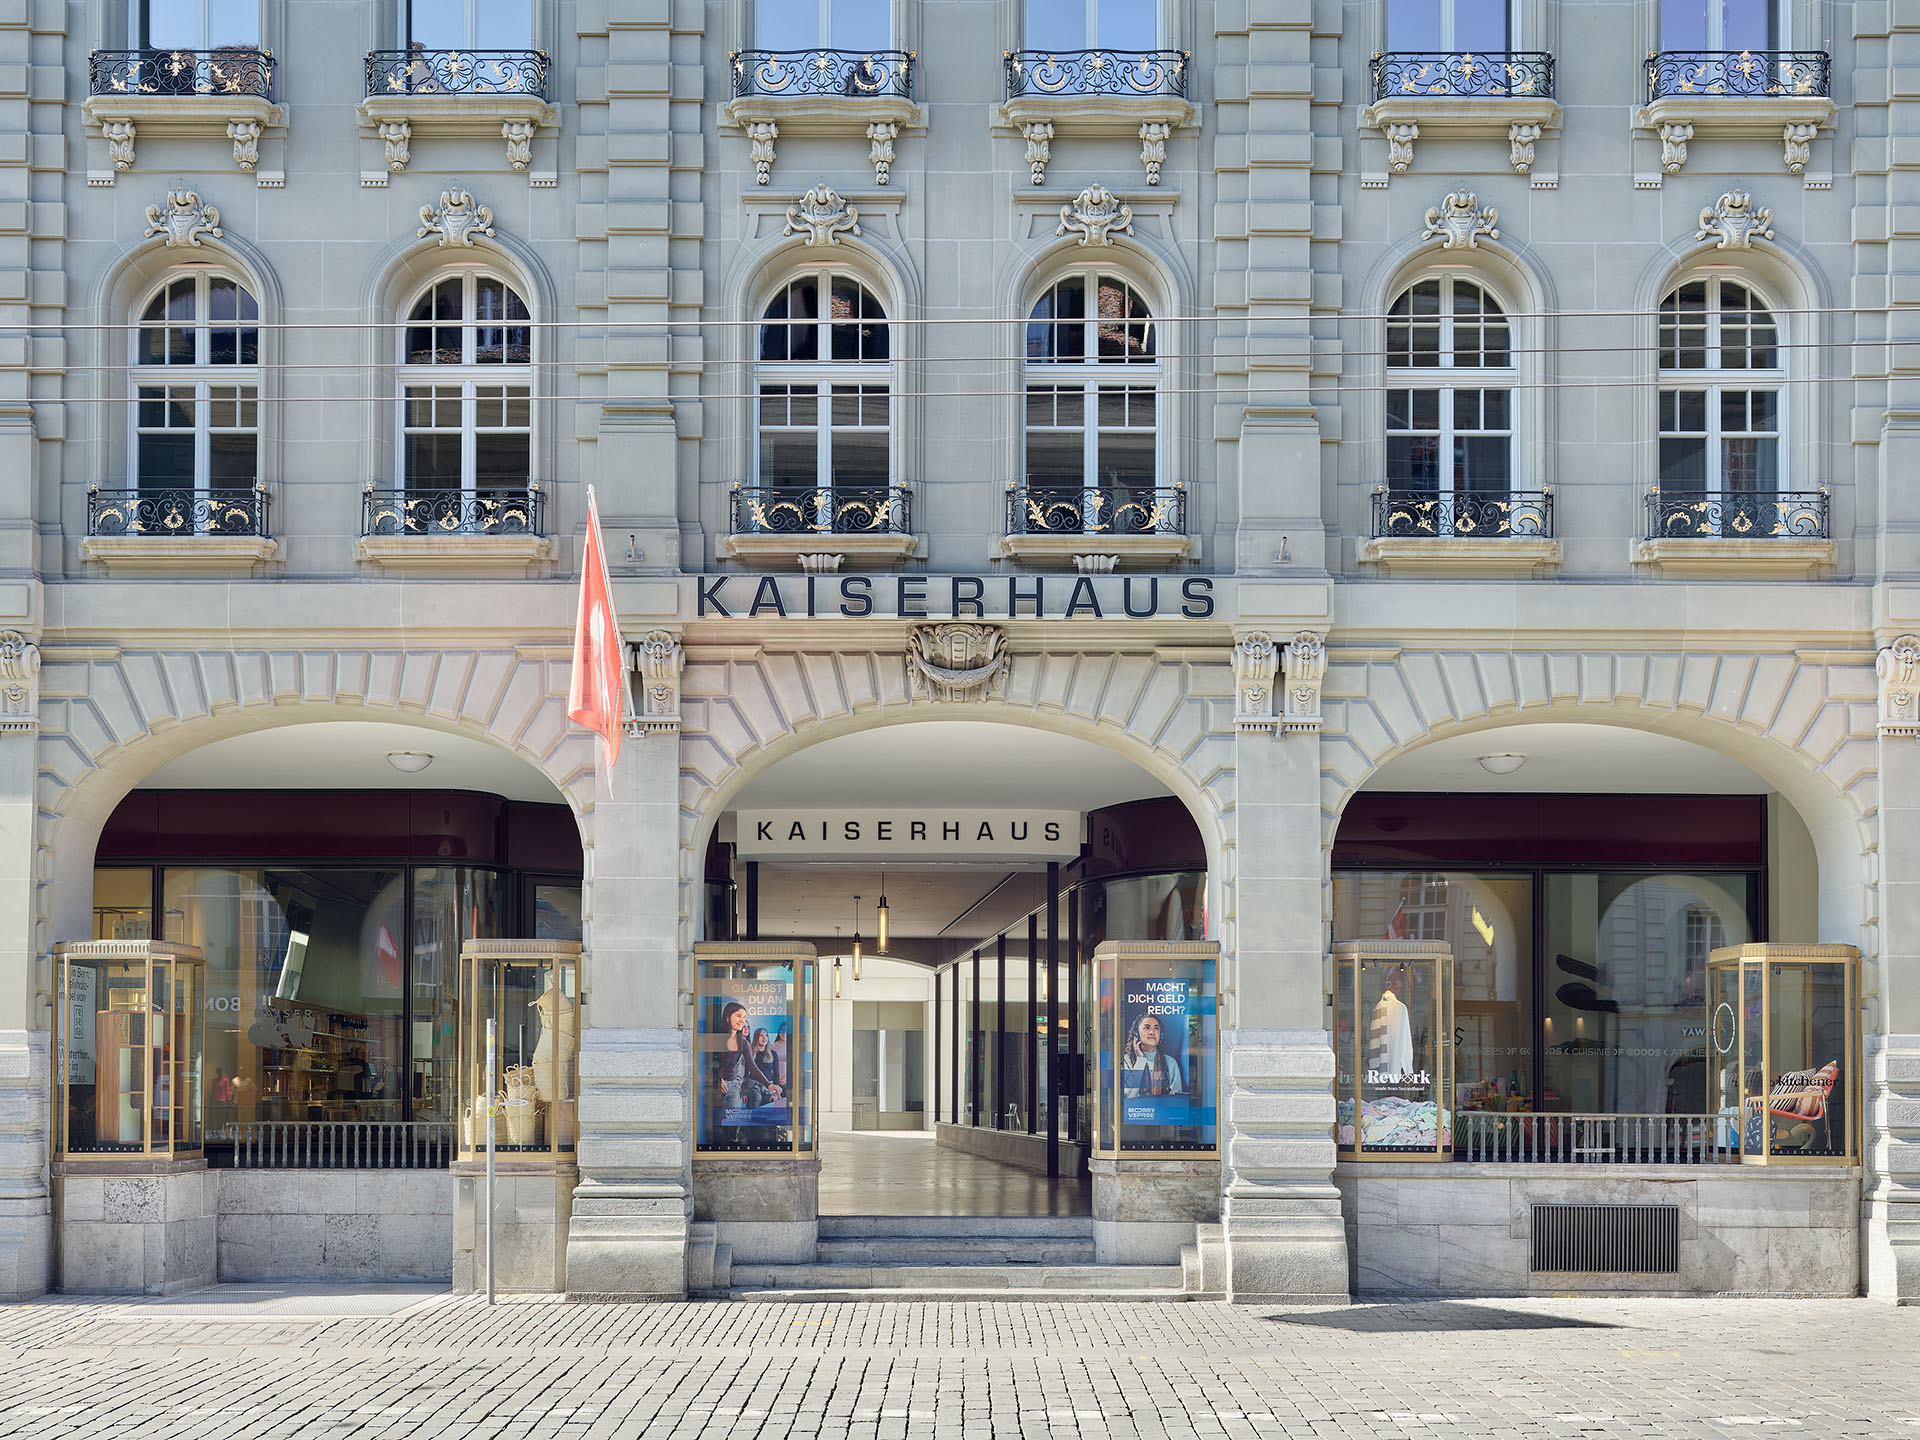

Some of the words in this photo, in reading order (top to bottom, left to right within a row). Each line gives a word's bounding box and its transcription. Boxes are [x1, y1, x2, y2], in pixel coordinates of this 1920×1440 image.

[697, 575, 1215, 619] KAISERHAUS
[756, 820, 1061, 842] KAISERHAUS
[732, 984, 783, 993] GLAUBST
[1146, 983, 1186, 992] MACHT
[749, 995, 764, 1005] DU
[767, 995, 783, 1005] AN
[1128, 994, 1154, 1003] DICH
[1157, 994, 1185, 1003] GELD
[748, 1006, 783, 1016] GELD?
[1148, 1006, 1185, 1015] REICH?
[1571, 1047, 1611, 1056] CUISINE
[1626, 1048, 1661, 1057] GOODS
[1778, 1075, 1839, 1087] kitchener
